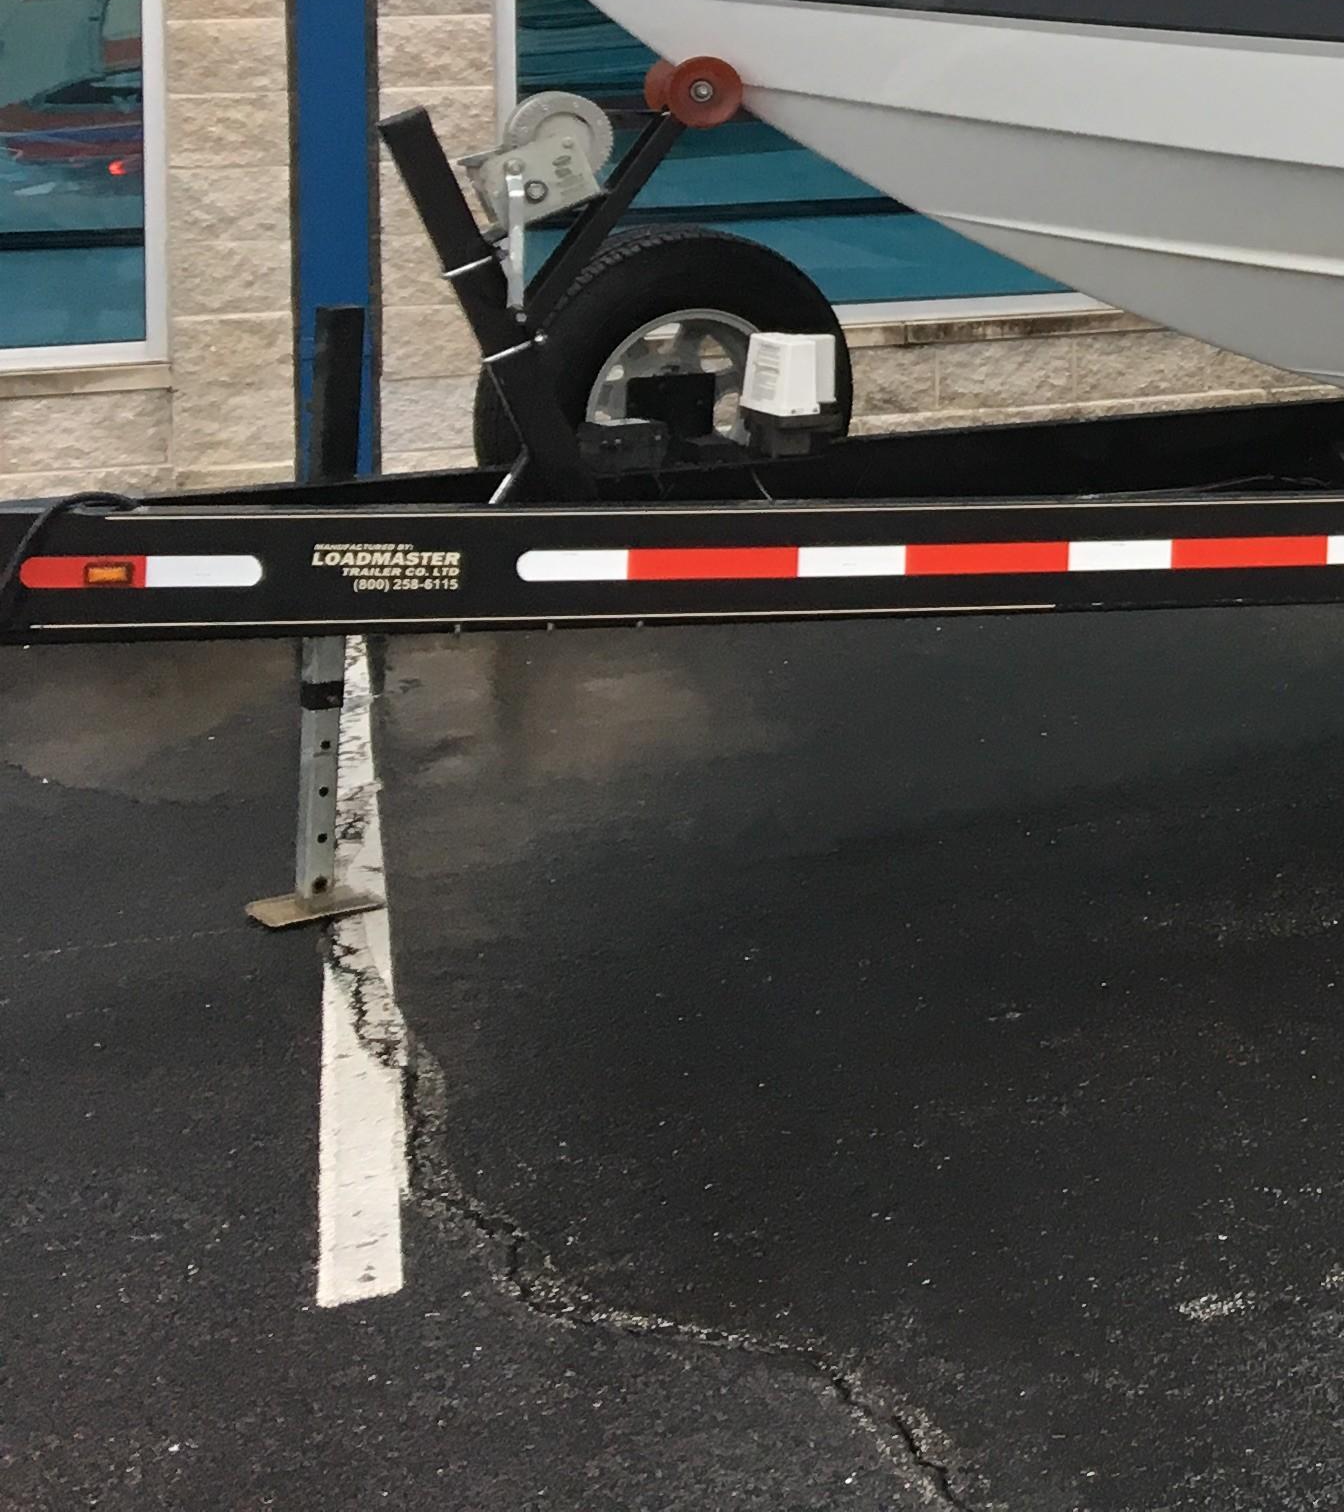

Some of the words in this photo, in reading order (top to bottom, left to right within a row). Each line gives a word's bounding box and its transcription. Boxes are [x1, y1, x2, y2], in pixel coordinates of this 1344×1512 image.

[313, 543, 395, 551] MANUFACTURED
[311, 551, 461, 566] LOADMASTER
[342, 567, 402, 577] TRAILER
[405, 567, 429, 577] CO.
[432, 567, 460, 577] LTD
[353, 578, 390, 593] (800)
[392, 578, 459, 590] 258-6115
